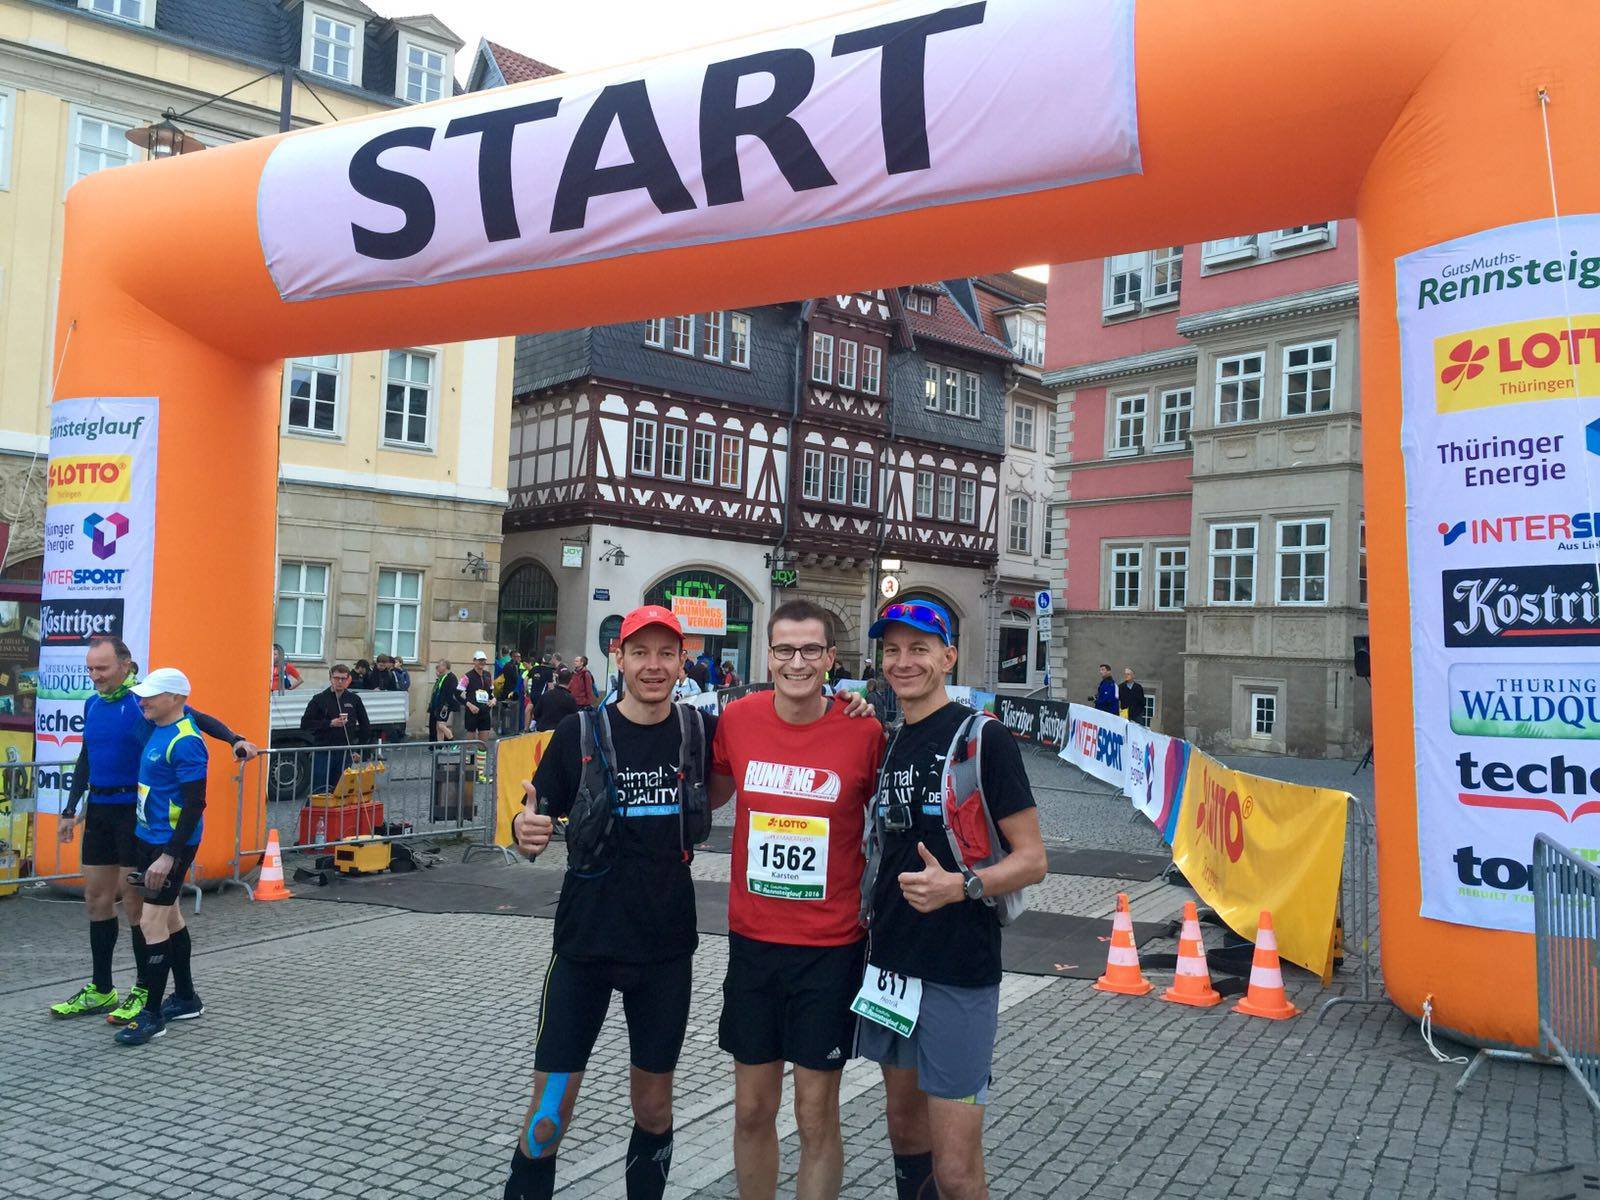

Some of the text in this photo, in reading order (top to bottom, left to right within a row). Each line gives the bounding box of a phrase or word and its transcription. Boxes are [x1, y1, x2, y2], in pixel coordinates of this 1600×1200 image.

[347, 1, 988, 261] START
[1442, 252, 1521, 279] GutsMuths-
[1500, 378, 1574, 396] Thüringen
[1437, 434, 1564, 464] Thüringer
[58, 462, 119, 486] LOTTO
[1465, 460, 1566, 487] Energie
[1471, 512, 1600, 544] INTERS
[771, 570, 796, 581] JOY
[665, 580, 727, 600] JOY
[1456, 752, 1600, 795] tech
[778, 819, 808, 829] LOTTO
[759, 842, 817, 872] 1562
[771, 871, 800, 881] Karsten
[804, 889, 821, 898] 2016
